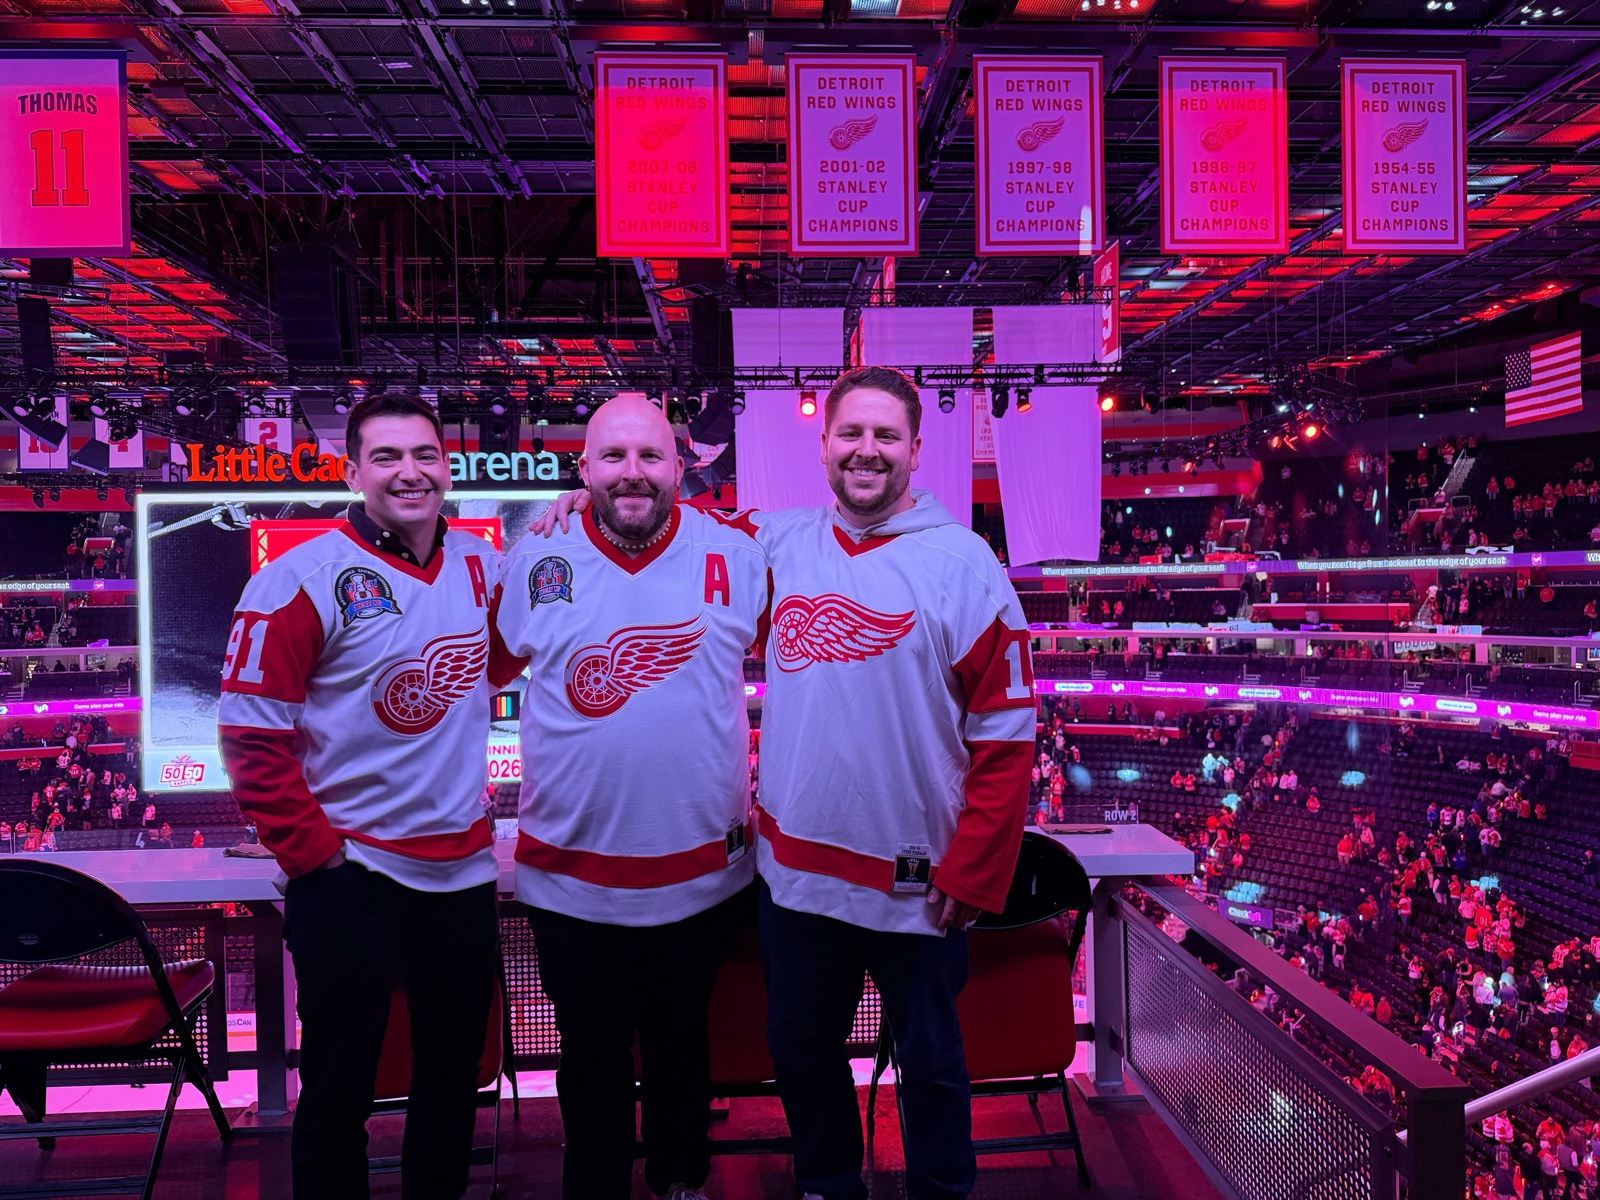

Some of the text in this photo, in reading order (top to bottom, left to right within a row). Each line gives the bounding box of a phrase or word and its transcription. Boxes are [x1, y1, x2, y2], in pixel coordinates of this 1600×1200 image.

[627, 77, 695, 90] DETROIT
[818, 77, 884, 90] DETROIT
[1006, 80, 1071, 92] DETROIT
[1191, 80, 1255, 92] DETROIT
[1372, 82, 1435, 94] DETROIT
[18, 92, 98, 115] THOMAS
[616, 96, 707, 109] RED WINGS
[807, 96, 896, 109] RED WINGS
[995, 99, 1083, 111] RED WINGS
[1180, 99, 1267, 111] RED WINGS
[1362, 101, 1446, 113] RED WINGS
[30, 129, 90, 207] 11
[627, 161, 697, 173] 2007-08
[820, 160, 885, 173] 2001-02
[1008, 162, 1072, 174] 1997-98
[1192, 161, 1256, 173] 1996-97
[1374, 162, 1435, 174] 1954-55
[627, 181, 698, 194] STANLEY
[818, 181, 887, 193] STANLEY
[1006, 182, 1075, 194] STANLEY
[1190, 181, 1258, 193] STANLEY
[1371, 182, 1438, 194] STANLEY
[648, 201, 678, 213] CUP
[838, 200, 868, 212] CUP
[1026, 201, 1055, 212] CUP
[1210, 200, 1239, 212] CUP
[1391, 200, 1420, 212] CUP
[617, 220, 710, 233] CHAMPIONS
[808, 219, 898, 232] CHAMPIONS
[996, 219, 1084, 232] CHAMPIONS
[1181, 218, 1268, 231] CHAMPIONS
[1362, 219, 1448, 231] CHAMPIONS
[186, 444, 286, 482] Little
[448, 451, 559, 481] arena
[464, 554, 490, 609] A
[704, 553, 730, 607] A
[222, 618, 269, 684] 91
[164, 766, 202, 780] 50 50
[1104, 810, 1136, 821] ROW 2
